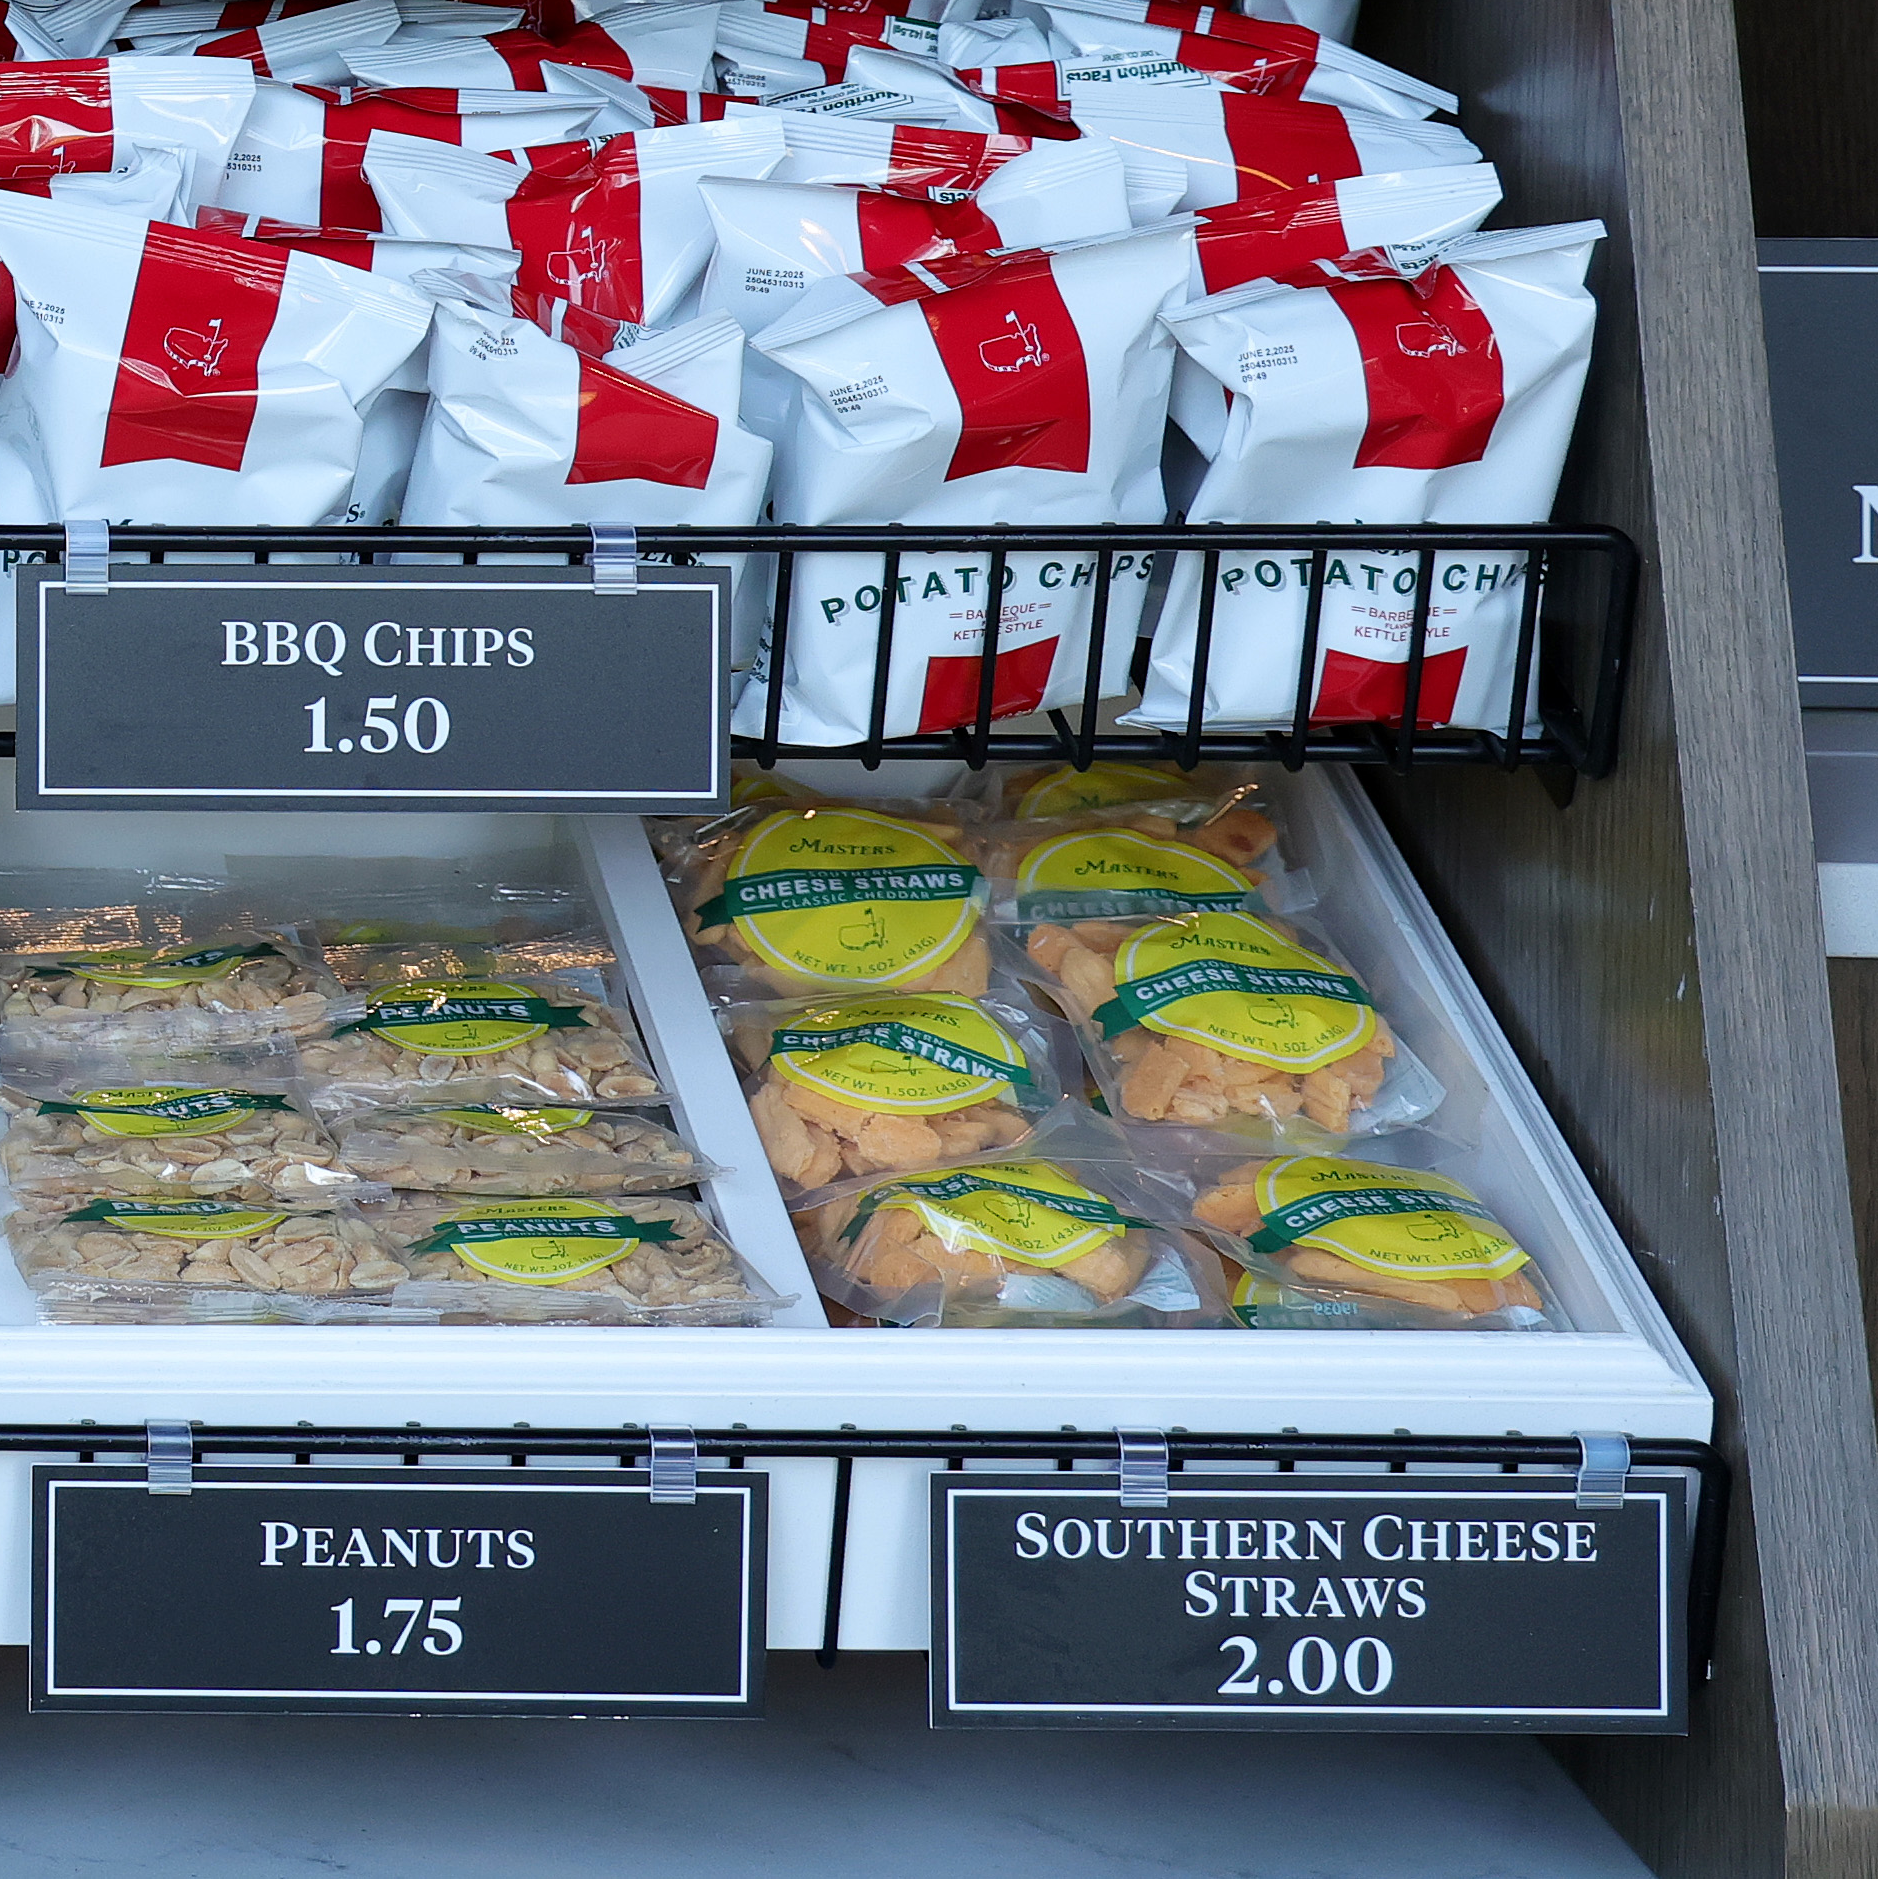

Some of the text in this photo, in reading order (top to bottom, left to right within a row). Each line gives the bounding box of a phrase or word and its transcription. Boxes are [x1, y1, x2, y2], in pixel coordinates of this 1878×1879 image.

[1039, 552, 1154, 590] CHPS
[1221, 557, 1417, 596] POTATO
[1005, 618, 1044, 634] STYLE
[1354, 625, 1408, 643] KETTLE
[221, 622, 534, 676] BBQ CHIPS
[304, 695, 449, 753] 1.50
[789, 838, 896, 855] MASTERS
[1074, 860, 1179, 881] MASTERS
[740, 872, 964, 902] CHEESE STRAWS
[782, 891, 930, 909] CLASSIC CHEDDAR
[794, 949, 820, 968] NET
[1169, 934, 1271, 956] MASTERS
[1135, 970, 1350, 1001] CHEESE STRAWS
[380, 1001, 528, 1021] PEANUTS
[1208, 1024, 1237, 1041] NET
[900, 1033, 1011, 1083] STRAWS
[821, 1068, 849, 1084] NET
[936, 1078, 972, 1096] (43G)
[1285, 1195, 1390, 1228] CHEESE
[457, 1219, 618, 1235] PEANUTS
[1369, 1248, 1401, 1262] NET
[261, 1522, 534, 1568] PEANUTS
[1016, 1513, 1597, 1561] SOUTHERN CHEESE
[1186, 1571, 1425, 1618] STRAWS
[331, 1597, 462, 1655] 1.75
[1218, 1636, 1392, 1695] 2.00
